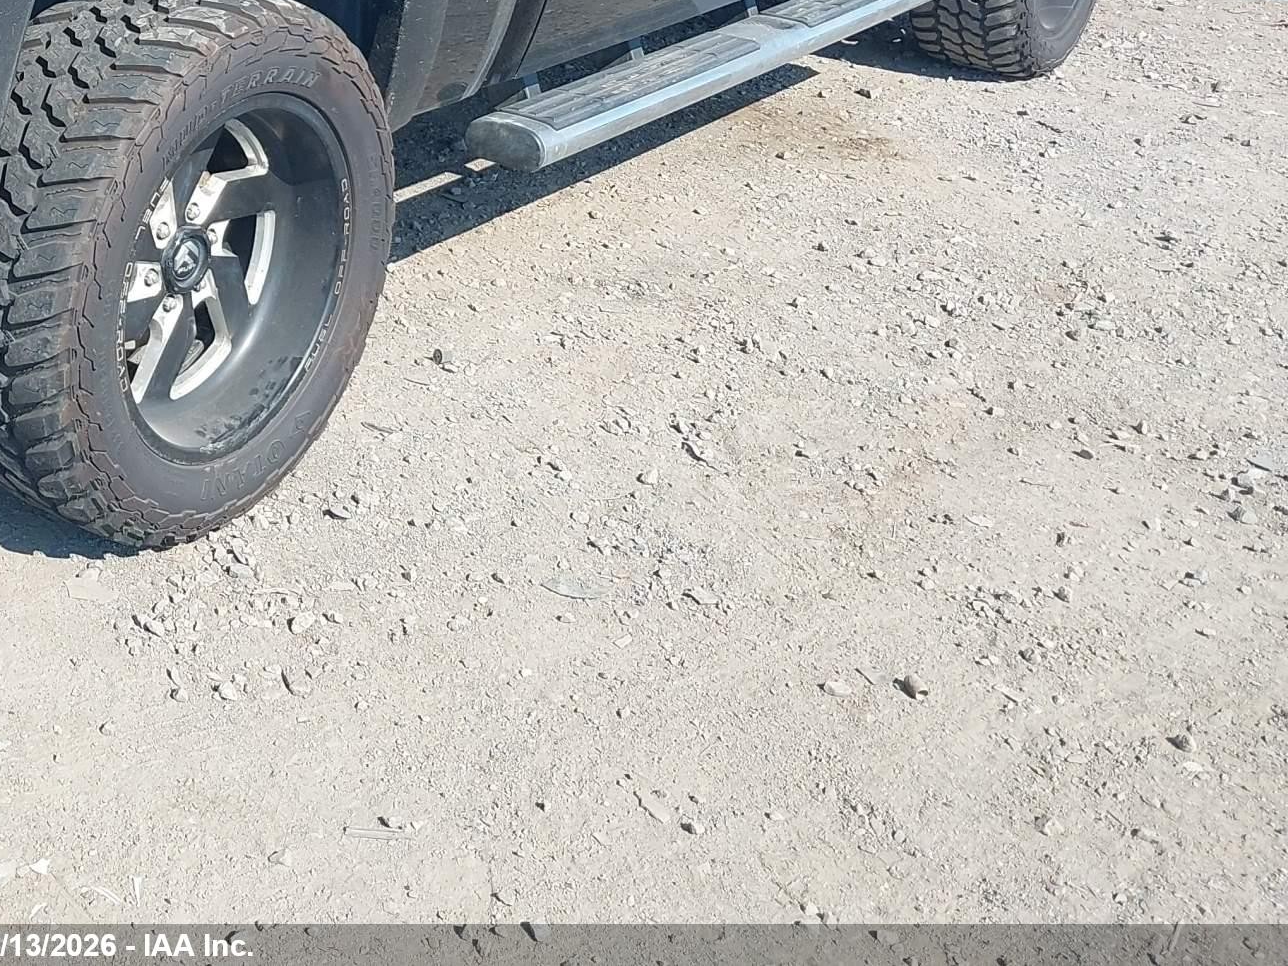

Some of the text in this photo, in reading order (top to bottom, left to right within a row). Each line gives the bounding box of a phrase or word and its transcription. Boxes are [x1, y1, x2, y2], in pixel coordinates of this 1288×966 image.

[220, 65, 321, 105] TERRAIN
[303, 177, 353, 375] FUEL OFF-ROAD
